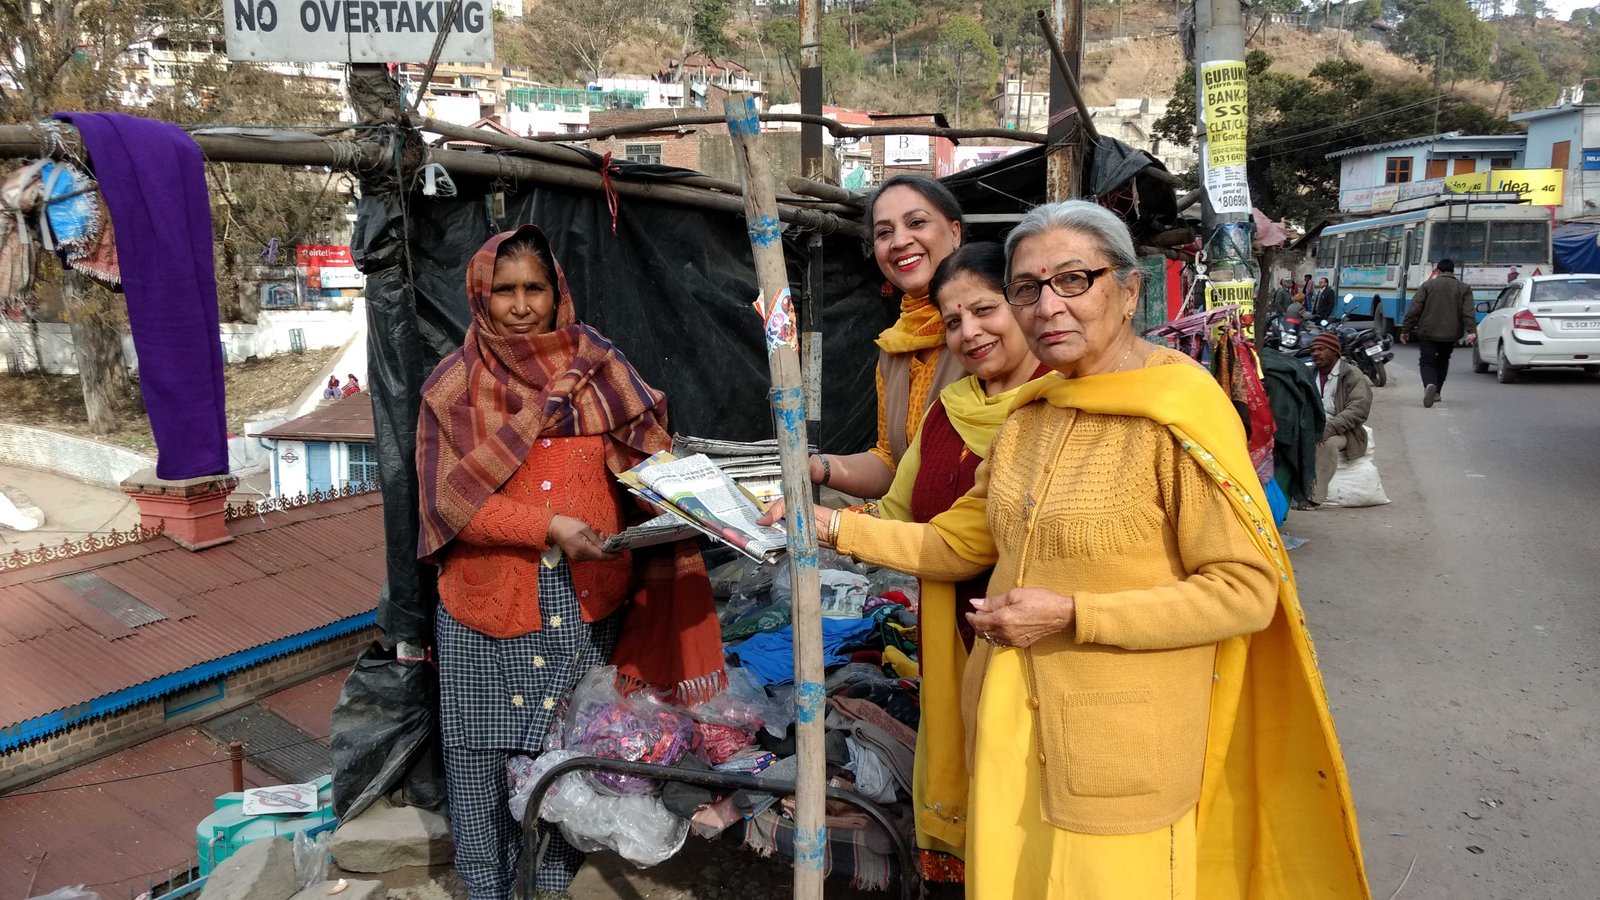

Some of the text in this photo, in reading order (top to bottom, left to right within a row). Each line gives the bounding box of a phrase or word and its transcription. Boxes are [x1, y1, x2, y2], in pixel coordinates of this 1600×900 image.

[234, 0, 484, 33] NO OVERTAKING
[1541, 184, 1556, 192] 4G
[309, 249, 328, 257] airtel
